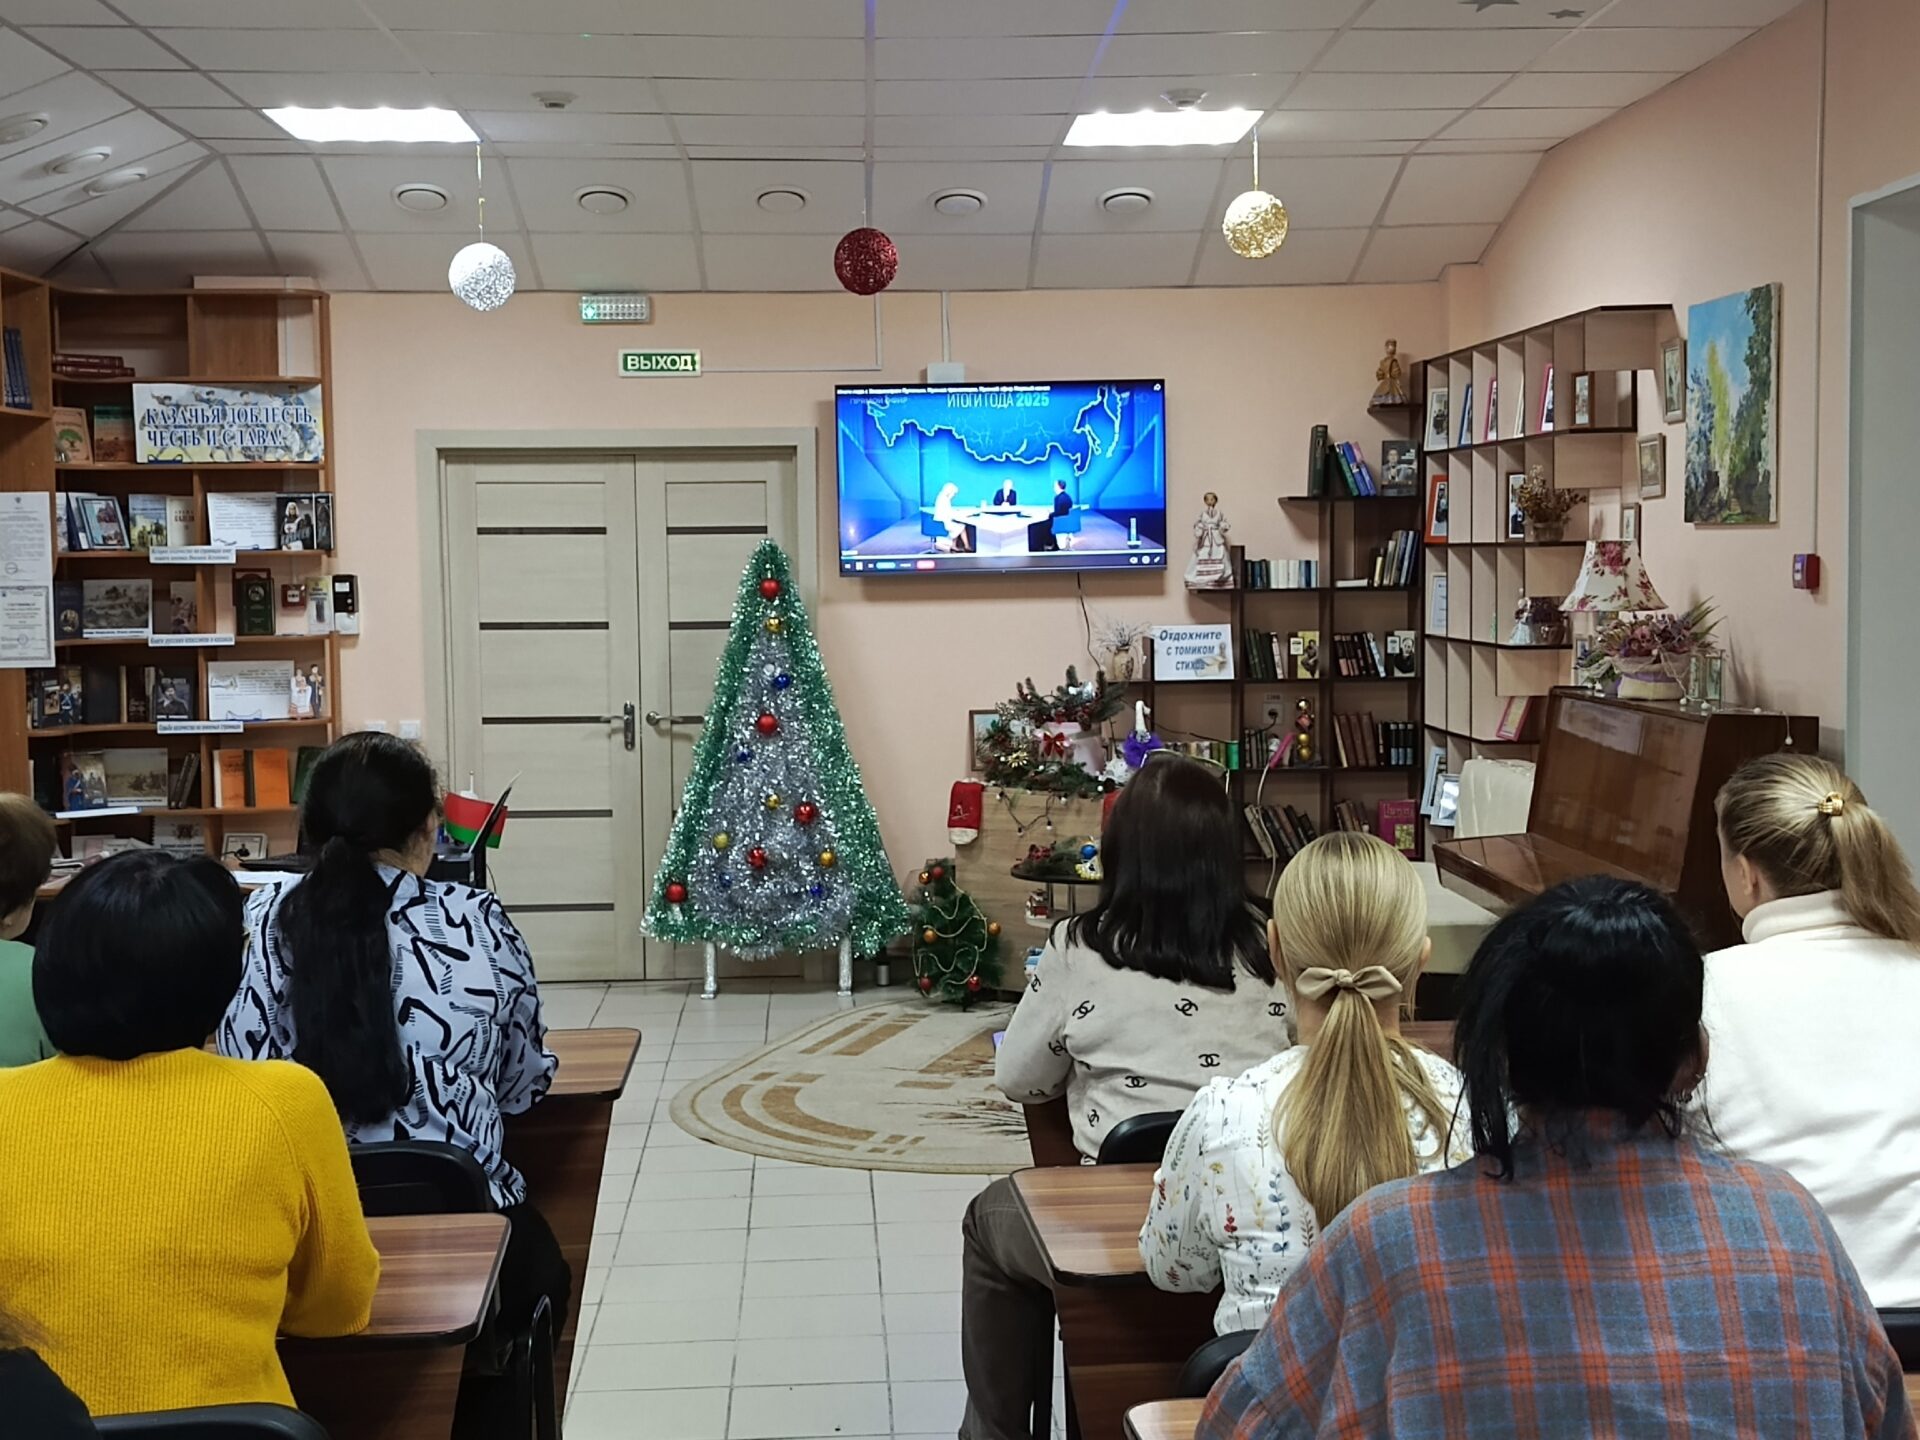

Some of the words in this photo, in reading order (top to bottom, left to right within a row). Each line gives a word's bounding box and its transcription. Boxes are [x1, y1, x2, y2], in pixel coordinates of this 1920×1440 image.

[627, 355, 693, 371] ВЫХОД
[946, 394, 982, 408] ИТОГИ
[985, 393, 1013, 408] ГОДА
[1015, 393, 1049, 407] 2025
[146, 407, 221, 425] КАЗАЧЬЯ
[148, 430, 201, 447] ЧЕСТЬ
[206, 430, 217, 446] И
[1160, 630, 1222, 642] Отдохните
